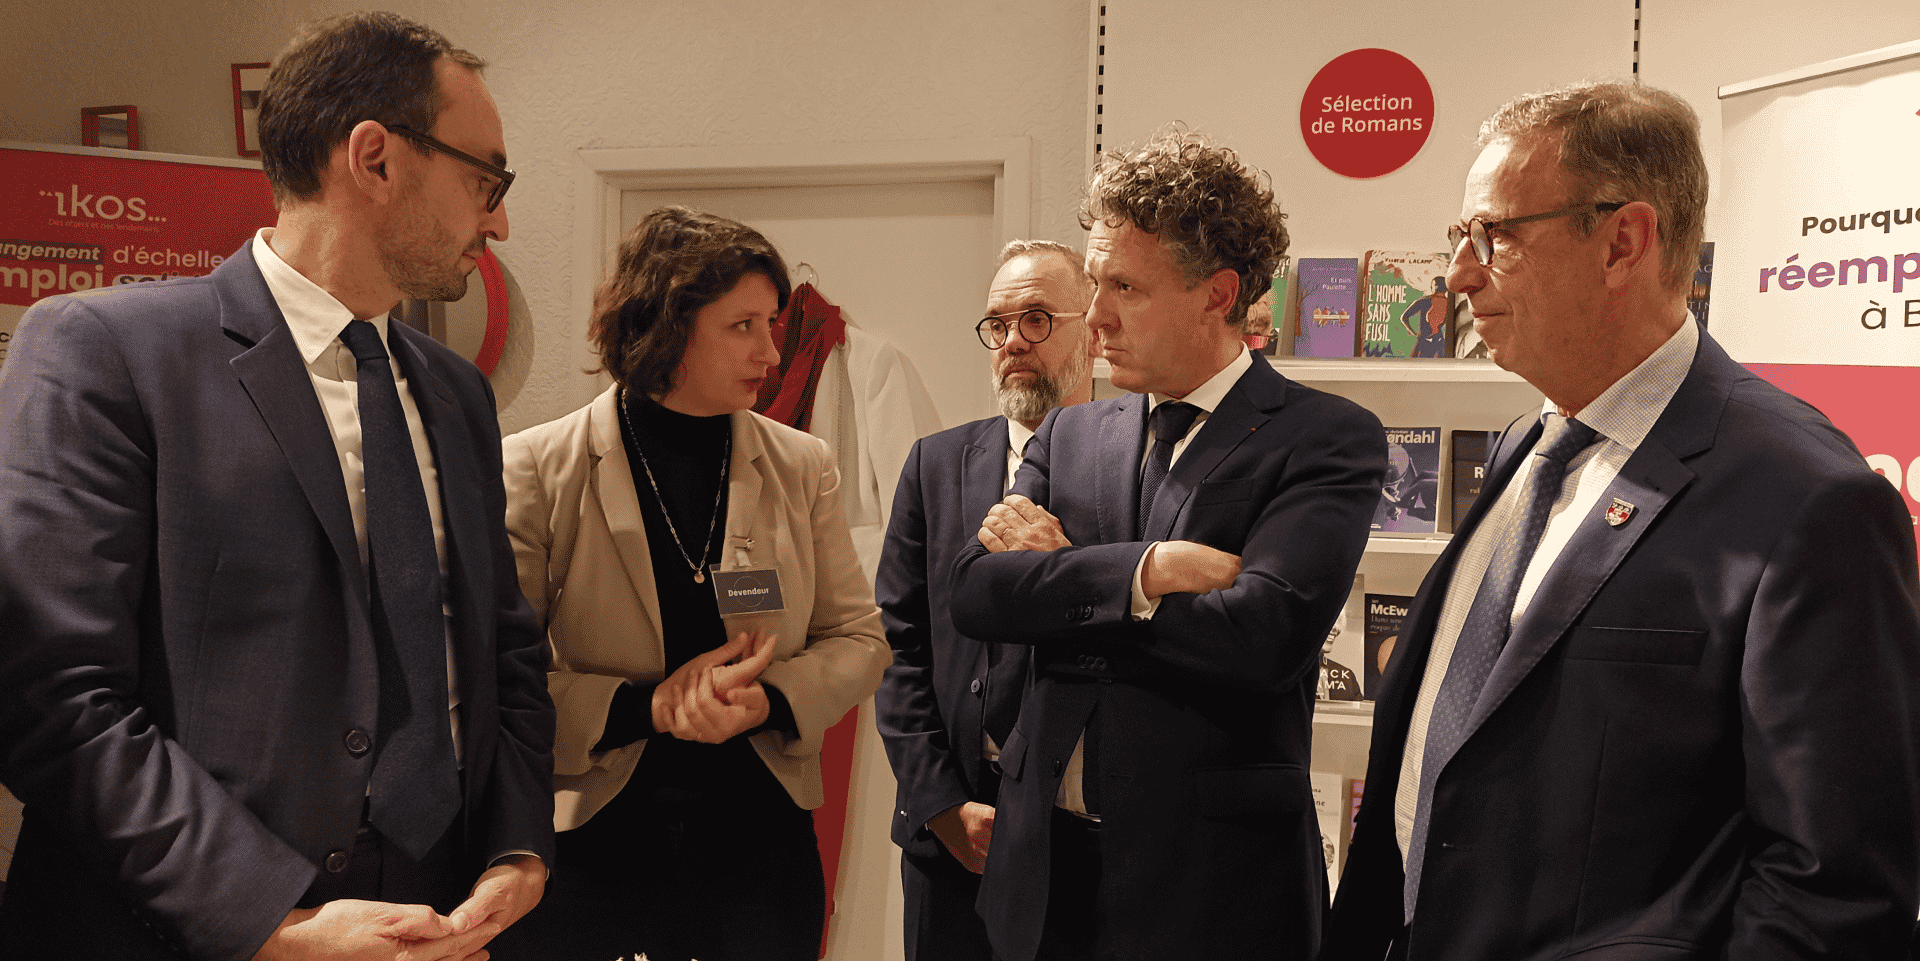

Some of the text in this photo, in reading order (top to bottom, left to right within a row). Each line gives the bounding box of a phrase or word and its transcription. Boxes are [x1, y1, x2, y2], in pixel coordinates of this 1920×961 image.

[1321, 94, 1412, 113] Sélection
[1311, 117, 1422, 134] de Romans
[0, 244, 224, 268] ngement d'échelle
[1759, 253, 1920, 293] réemp
[1366, 304, 1391, 322] SANS
[1861, 300, 1886, 330] à
[1365, 323, 1390, 341] FUSIL
[1386, 430, 1435, 444] øndahl
[1474, 466, 1484, 478] R
[1370, 603, 1408, 616] McEw
[1319, 669, 1350, 679] ACK
